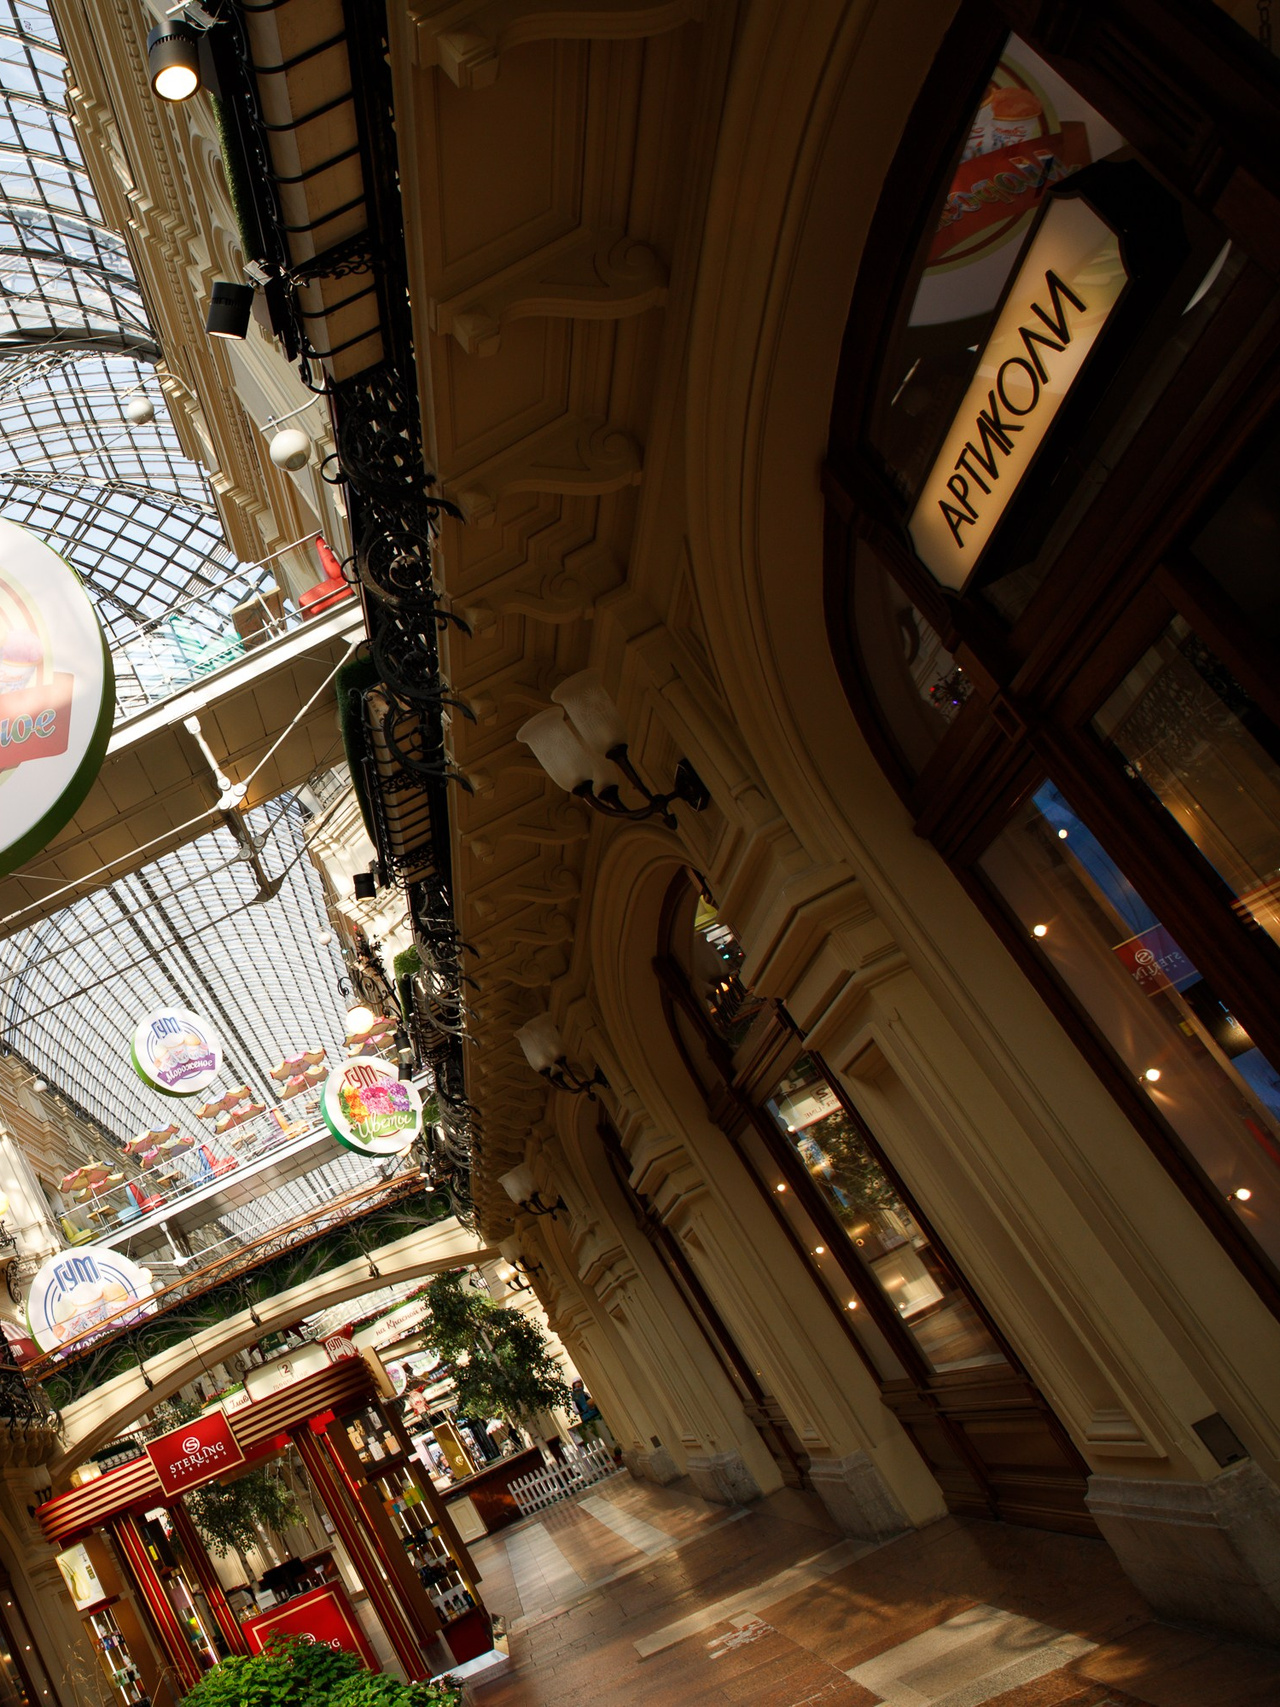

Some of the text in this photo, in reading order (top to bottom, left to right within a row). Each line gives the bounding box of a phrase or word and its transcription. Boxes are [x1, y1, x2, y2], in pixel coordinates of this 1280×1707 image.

[937, 268, 1088, 548] АРТИКОЛИ
[281, 1364, 291, 1374] 2
[169, 1441, 224, 1474] STERLING
